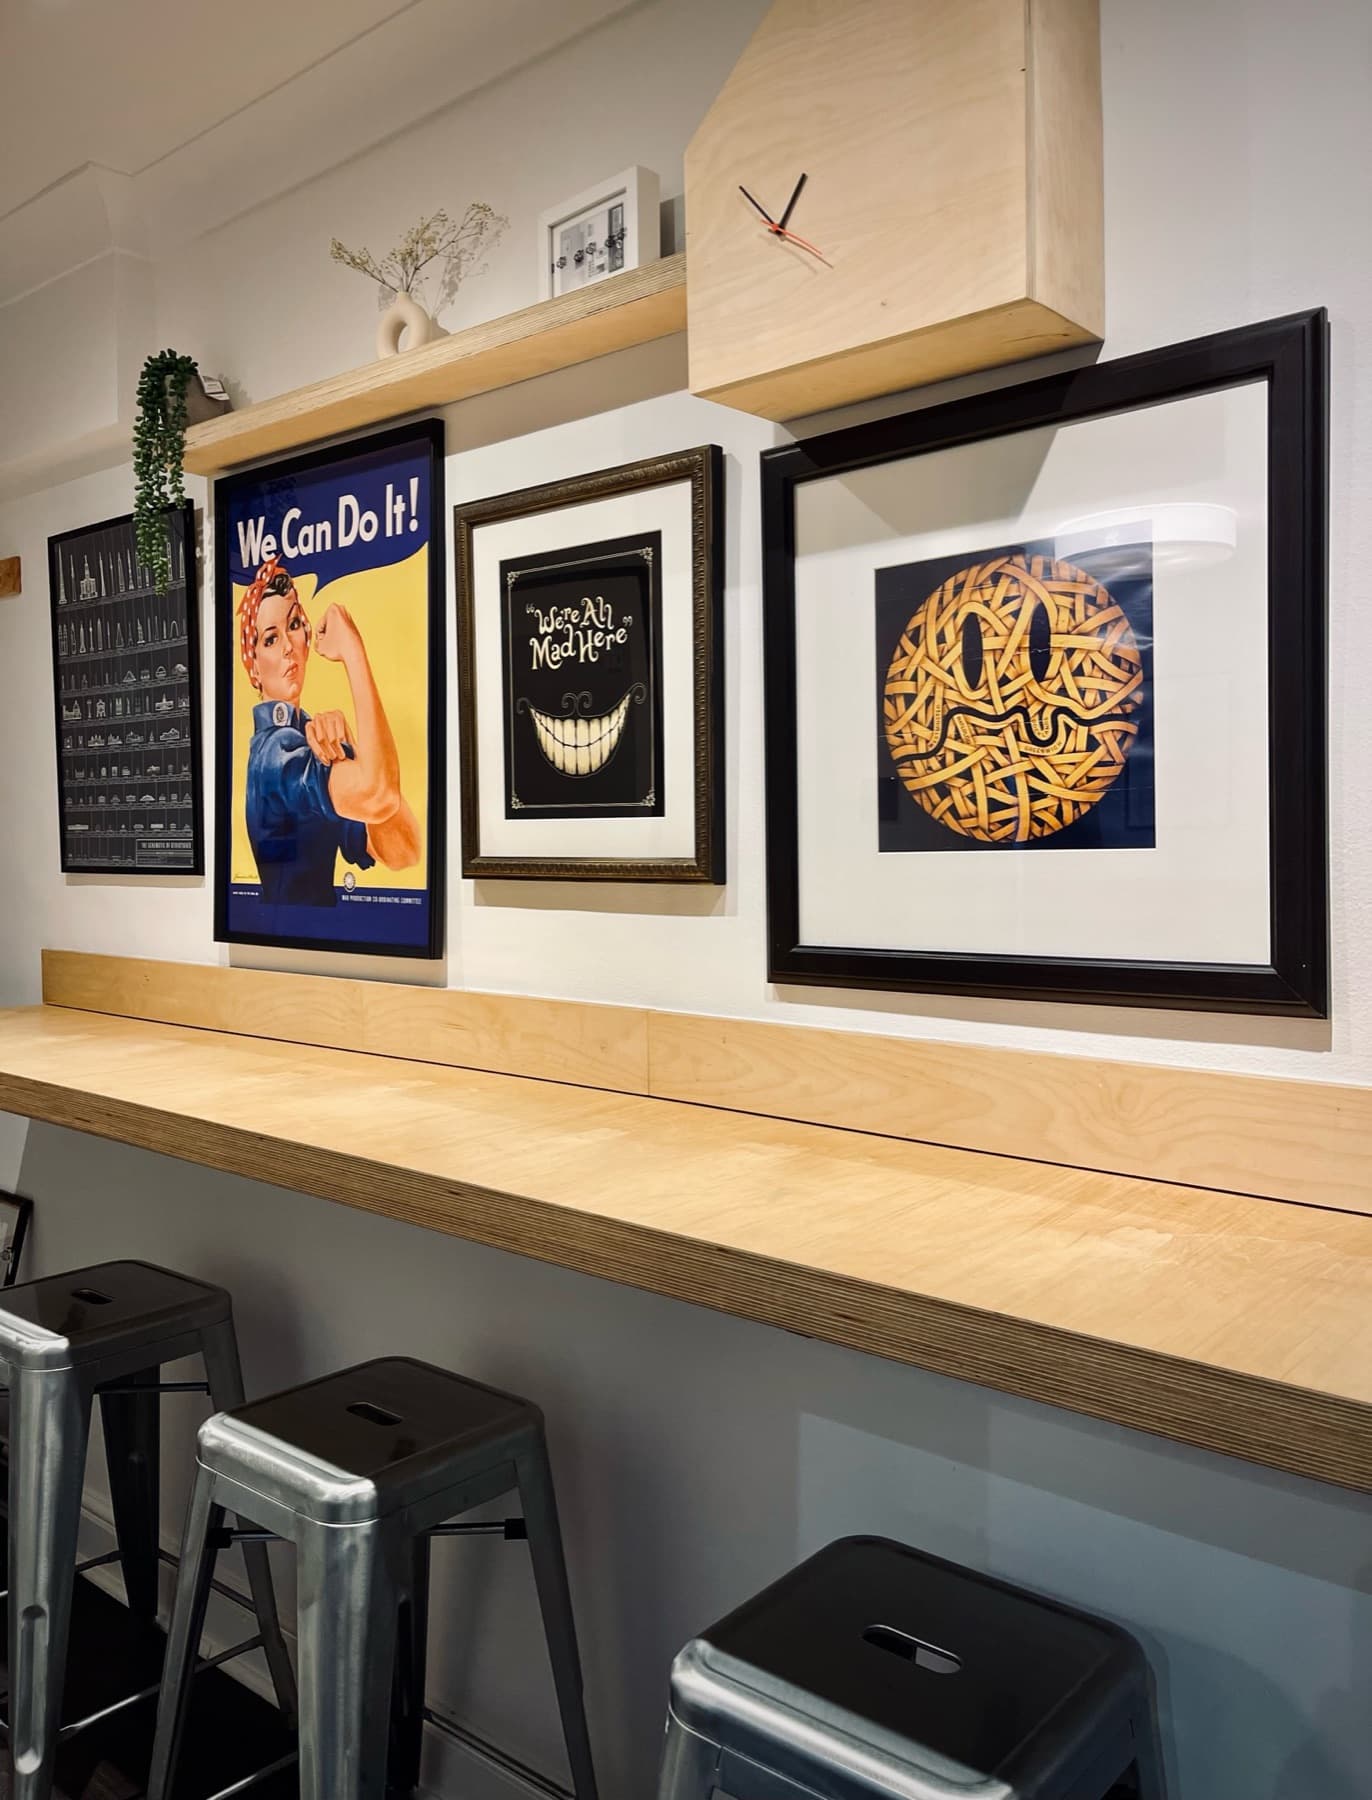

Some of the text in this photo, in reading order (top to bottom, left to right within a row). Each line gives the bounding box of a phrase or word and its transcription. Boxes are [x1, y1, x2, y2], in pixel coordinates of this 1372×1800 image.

[237, 476, 419, 568] We Can Do It!
[580, 596, 614, 630] All
[529, 623, 577, 670] Mad
